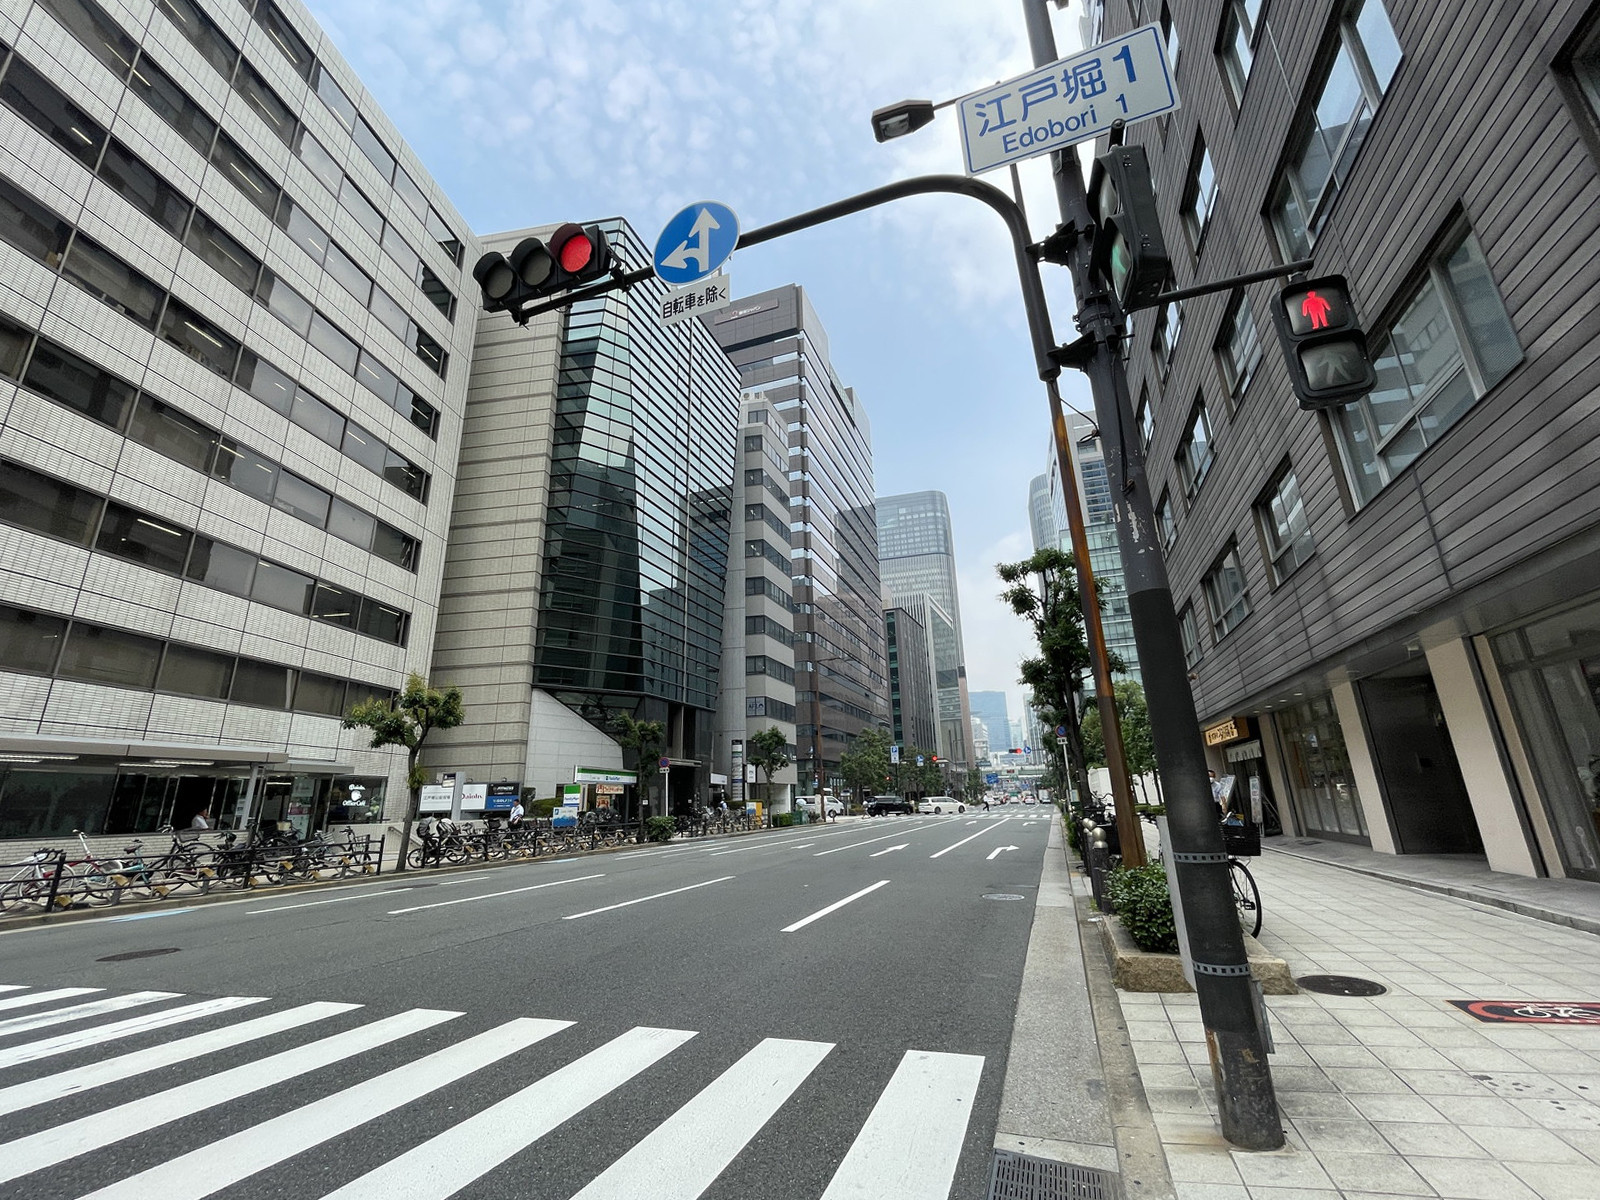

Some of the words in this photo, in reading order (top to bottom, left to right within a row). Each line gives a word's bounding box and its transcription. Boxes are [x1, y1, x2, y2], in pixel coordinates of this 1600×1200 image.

[1002, 104, 1098, 154] Edobori
[1115, 93, 1129, 114] 1
[661, 286, 727, 320] 自転車を除く
